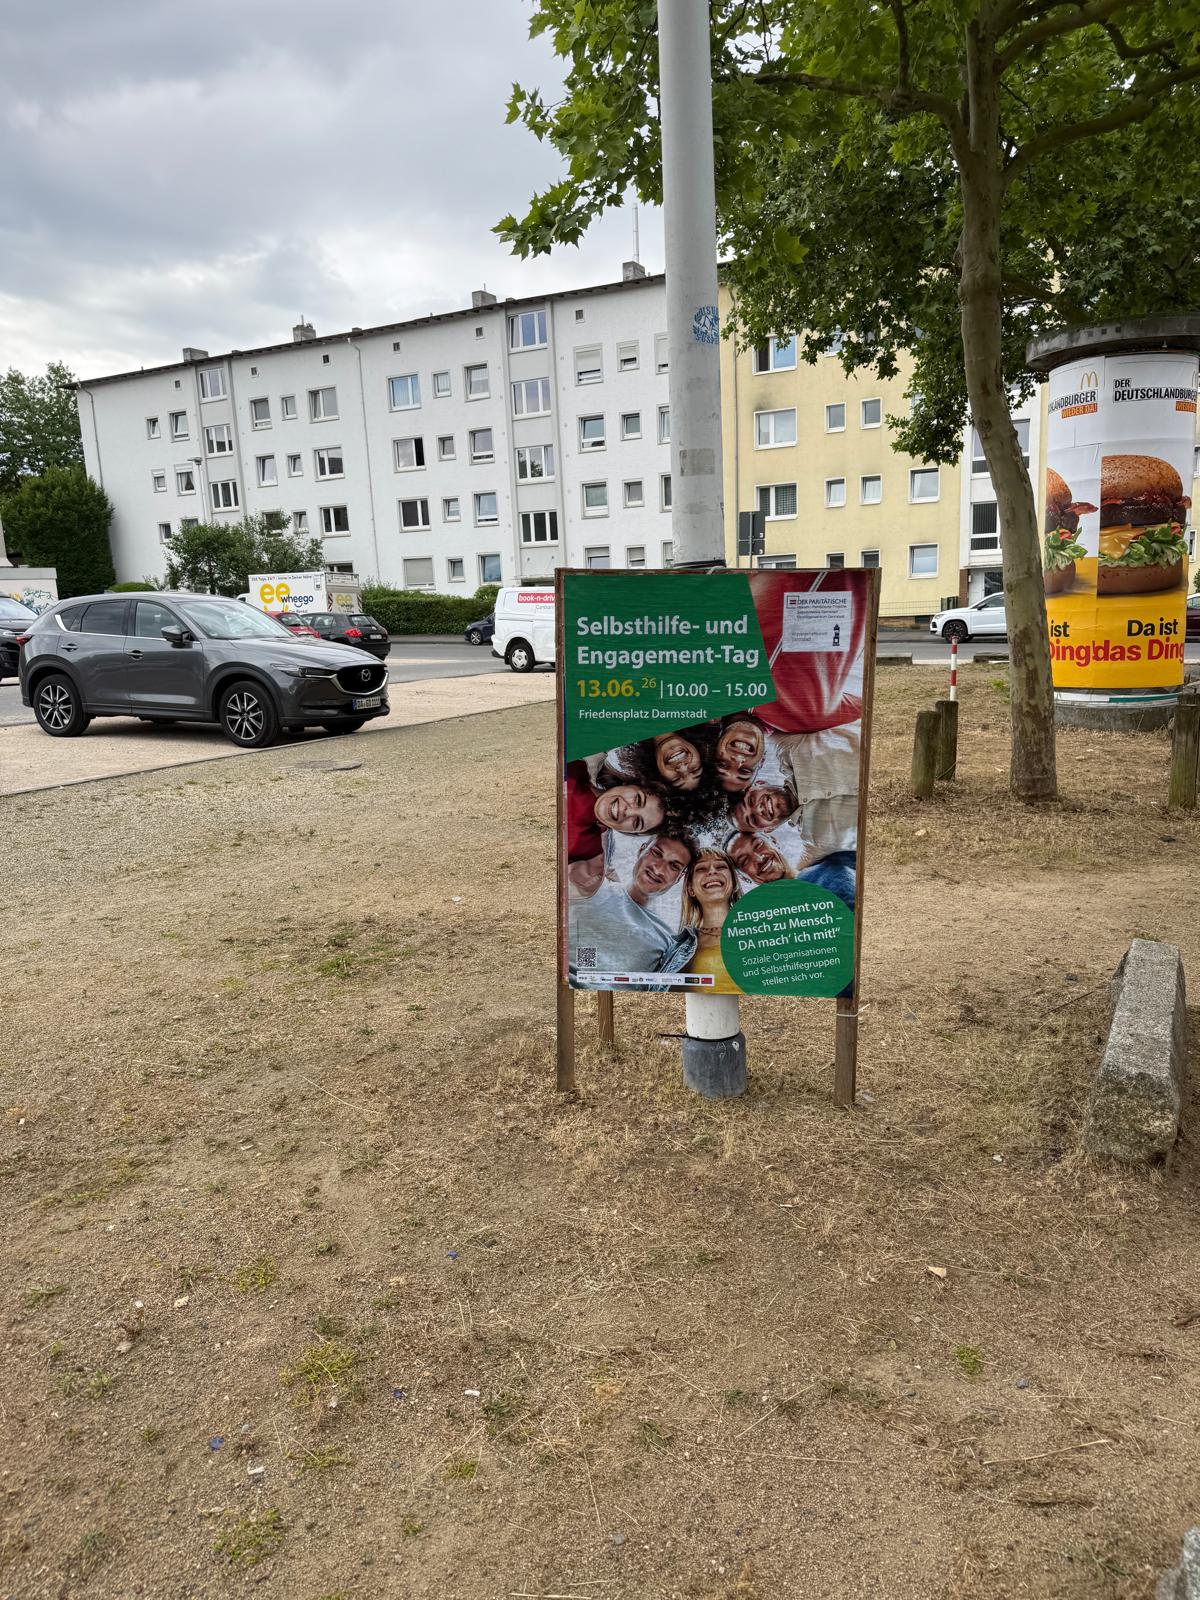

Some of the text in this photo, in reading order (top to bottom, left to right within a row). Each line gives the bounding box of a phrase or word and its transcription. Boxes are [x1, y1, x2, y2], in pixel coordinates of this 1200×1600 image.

[1114, 379, 1130, 388] DER
[280, 594, 314, 604] wheego
[577, 615, 748, 636] Selbsthilfe- und
[1051, 620, 1070, 637] ist
[1127, 617, 1178, 637] Da ist
[577, 645, 759, 669] Engagement-Tag
[1093, 640, 1141, 661] das
[725, 683, 767, 697] 15.00
[579, 708, 707, 721] Friedensplatz Darmstadt
[812, 901, 834, 911] von
[727, 923, 771, 938] Mensch
[773, 922, 787, 931] zu
[789, 914, 833, 929] Mensch
[738, 940, 756, 951] DA
[794, 931, 811, 943] ich
[742, 946, 838, 966] Soziale Organisationen
[743, 957, 841, 978] und Selbsthilfegruppen
[761, 971, 825, 986] stellen sich vor.
